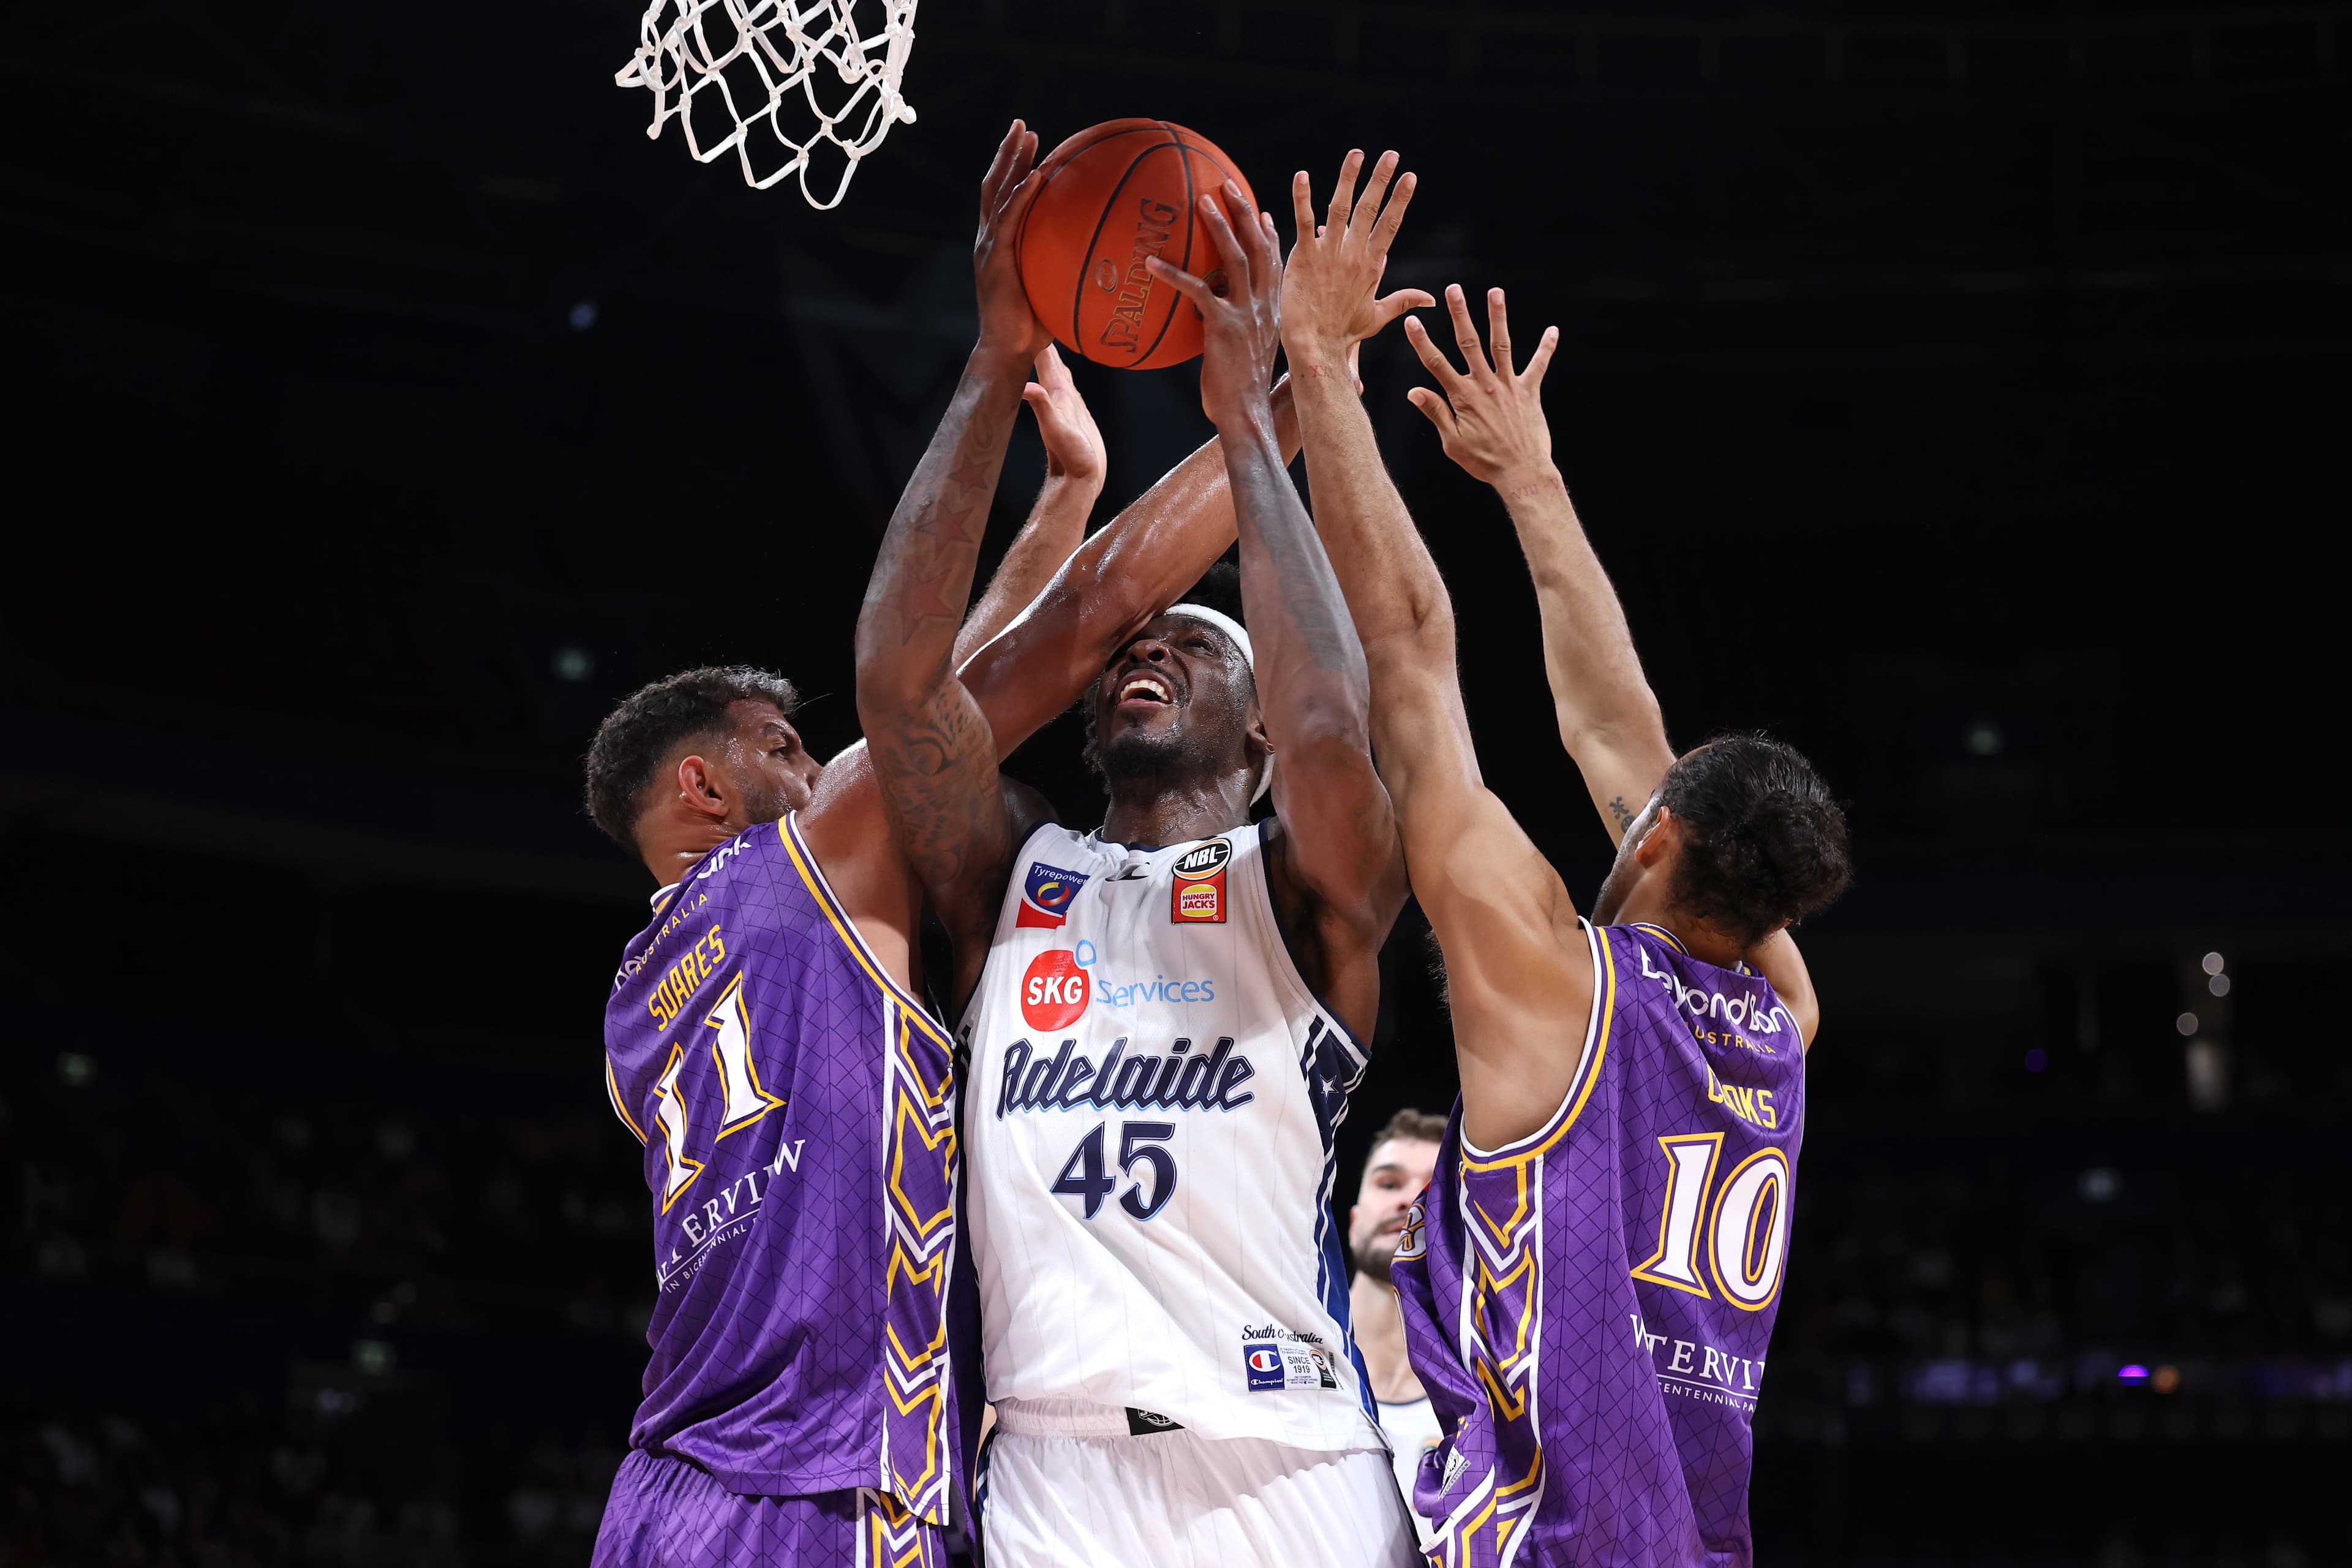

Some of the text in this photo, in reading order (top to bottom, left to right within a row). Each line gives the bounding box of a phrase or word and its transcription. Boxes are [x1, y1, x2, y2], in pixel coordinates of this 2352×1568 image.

[1100, 197, 1177, 353] SPALDING
[1183, 846, 1218, 870] NBL
[1034, 865, 1088, 885] Tyrepower
[1182, 900, 1215, 910] JACK'S
[635, 893, 708, 974] AUSTRALIA
[648, 924, 726, 1031] SOARES
[1027, 974, 1215, 1008] SKG Services
[1686, 1021, 1776, 1054] USTRALIA
[653, 970, 788, 1216] 11
[995, 1036, 1255, 1121] Adelaide
[1051, 1120, 1177, 1221] 45
[1630, 1131, 1790, 1312] 10
[665, 1280, 680, 1294] IN
[1242, 1324, 1276, 1340] South
[1287, 1356, 1311, 1365] SINCE
[1293, 1365, 1310, 1373] 1919
[1658, 1382, 1757, 1413] ENTENNIAL PA
